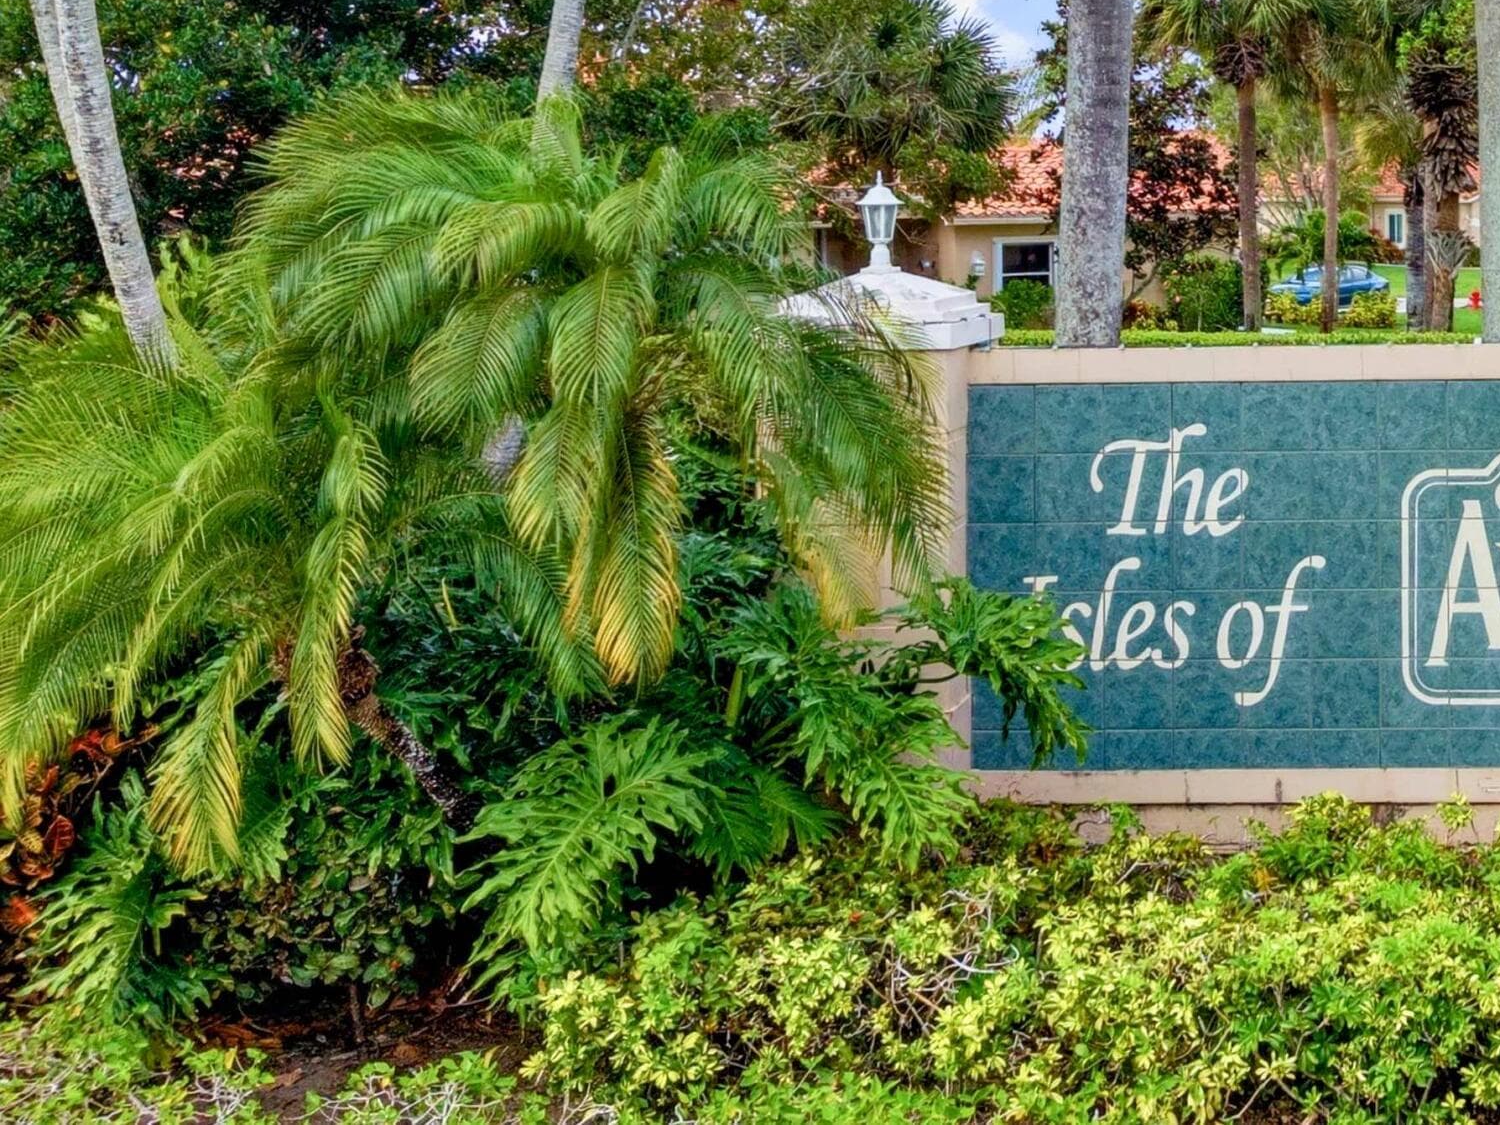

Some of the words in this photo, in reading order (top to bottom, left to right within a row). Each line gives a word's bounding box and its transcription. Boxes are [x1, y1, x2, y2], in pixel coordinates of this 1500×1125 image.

[1090, 423, 1250, 538] The
[1021, 556, 1197, 672] sles
[1215, 555, 1327, 707] of
